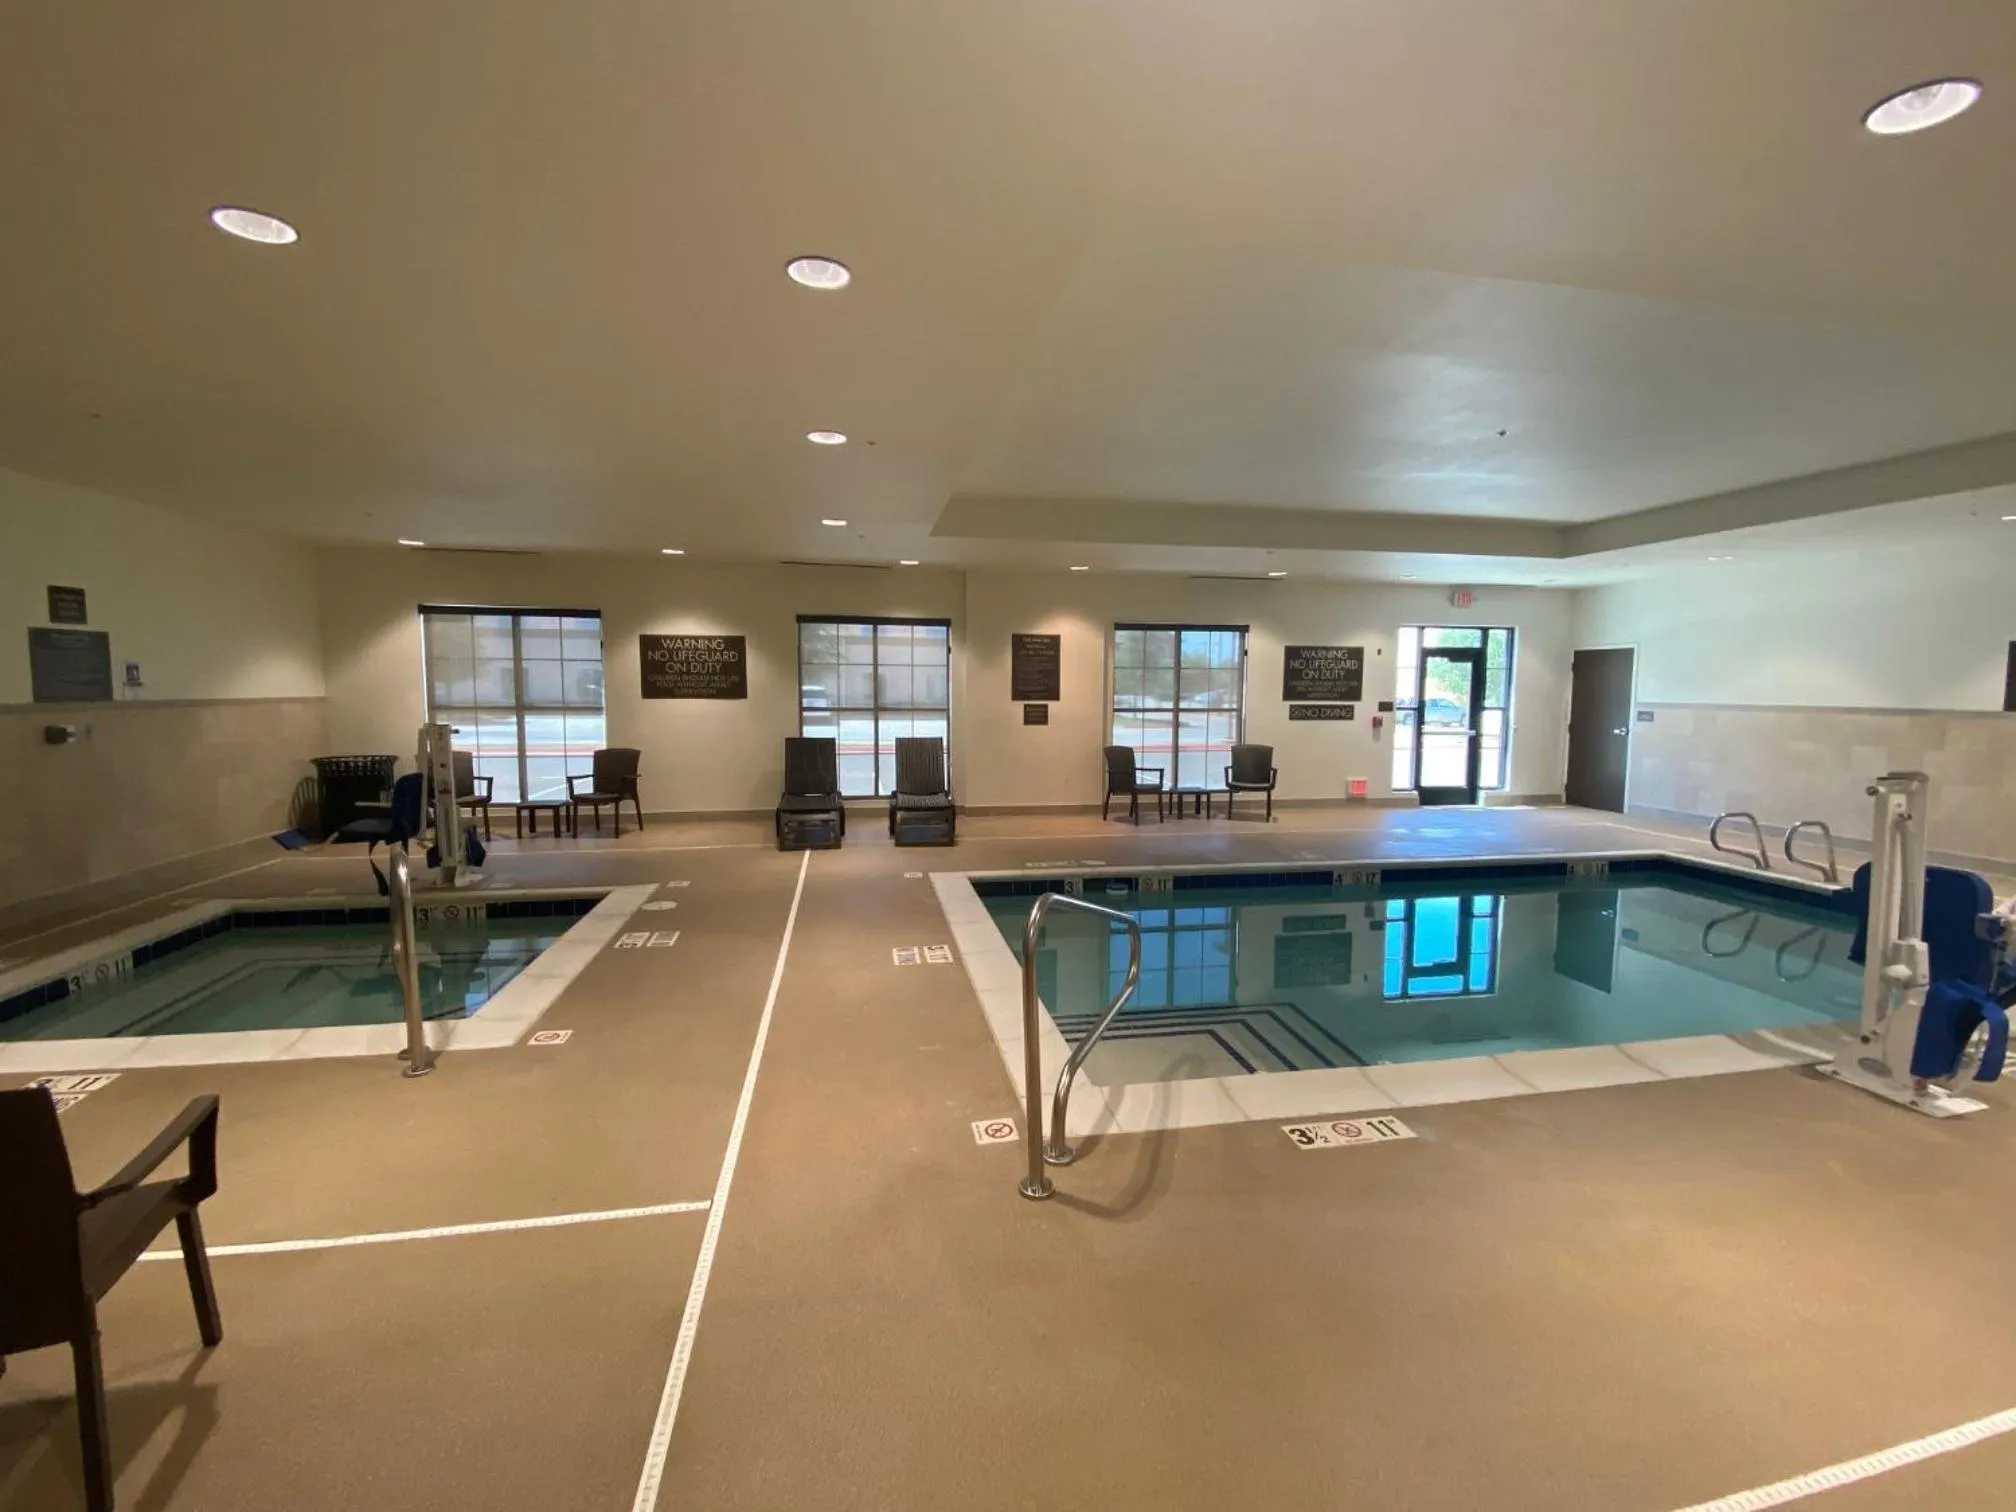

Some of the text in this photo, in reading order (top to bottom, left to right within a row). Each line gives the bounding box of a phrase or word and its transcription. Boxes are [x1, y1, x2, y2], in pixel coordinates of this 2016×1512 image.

[661, 638, 725, 650] WARNING
[648, 650, 740, 662] NO LIFEGUARD
[1300, 649, 1348, 659] WARNING
[665, 662, 722, 674] ON DUTY
[1289, 659, 1359, 670] NO LIFEGUARD
[1302, 669, 1346, 680] ON DUTY
[1303, 708, 1353, 717] NO DIVING
